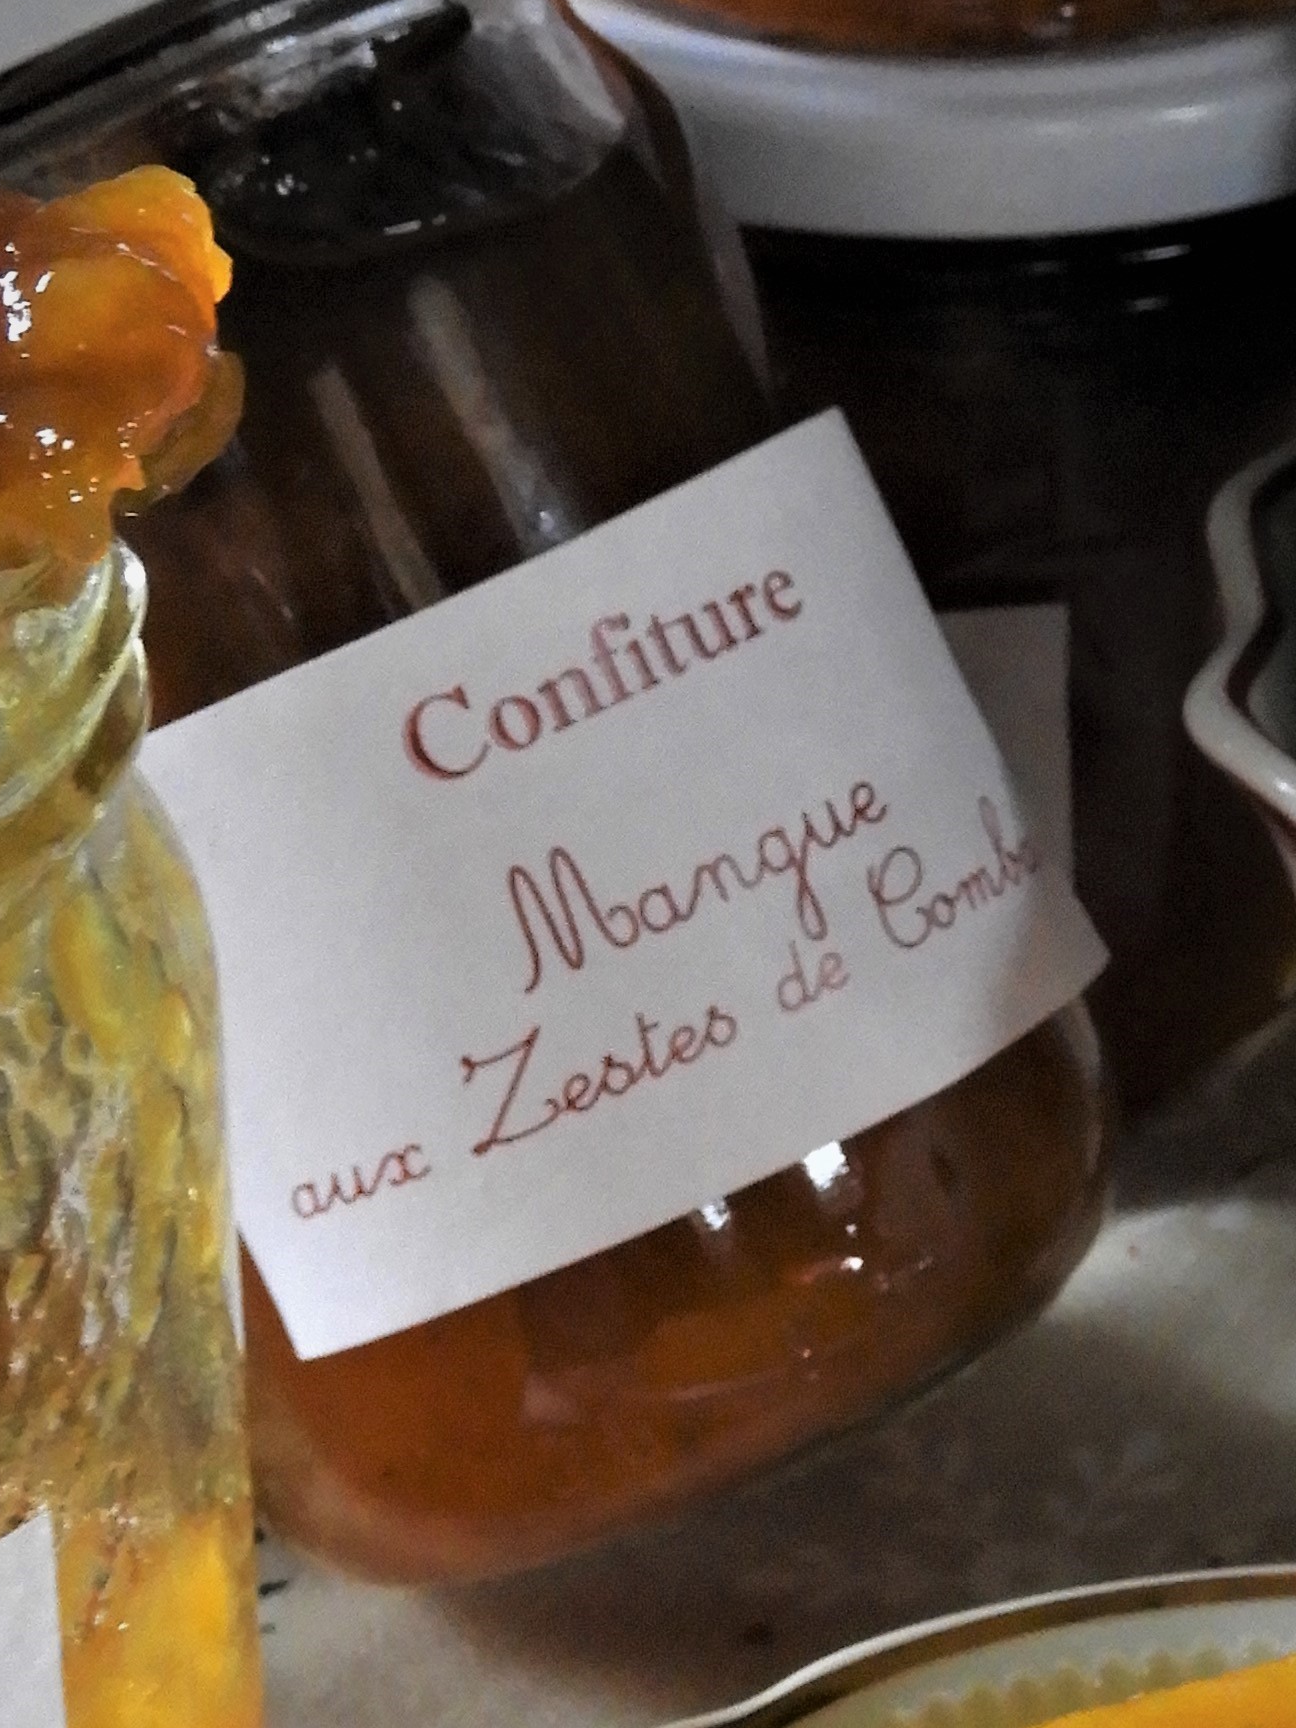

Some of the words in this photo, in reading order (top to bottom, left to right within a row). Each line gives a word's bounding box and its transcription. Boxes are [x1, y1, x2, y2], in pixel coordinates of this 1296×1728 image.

[402, 567, 804, 781] Confiture
[500, 780, 890, 994] Mangue
[291, 1138, 432, 1220] aux
[461, 1002, 738, 1156] Zestes
[776, 947, 850, 1016] de
[868, 795, 1040, 950] Comb
